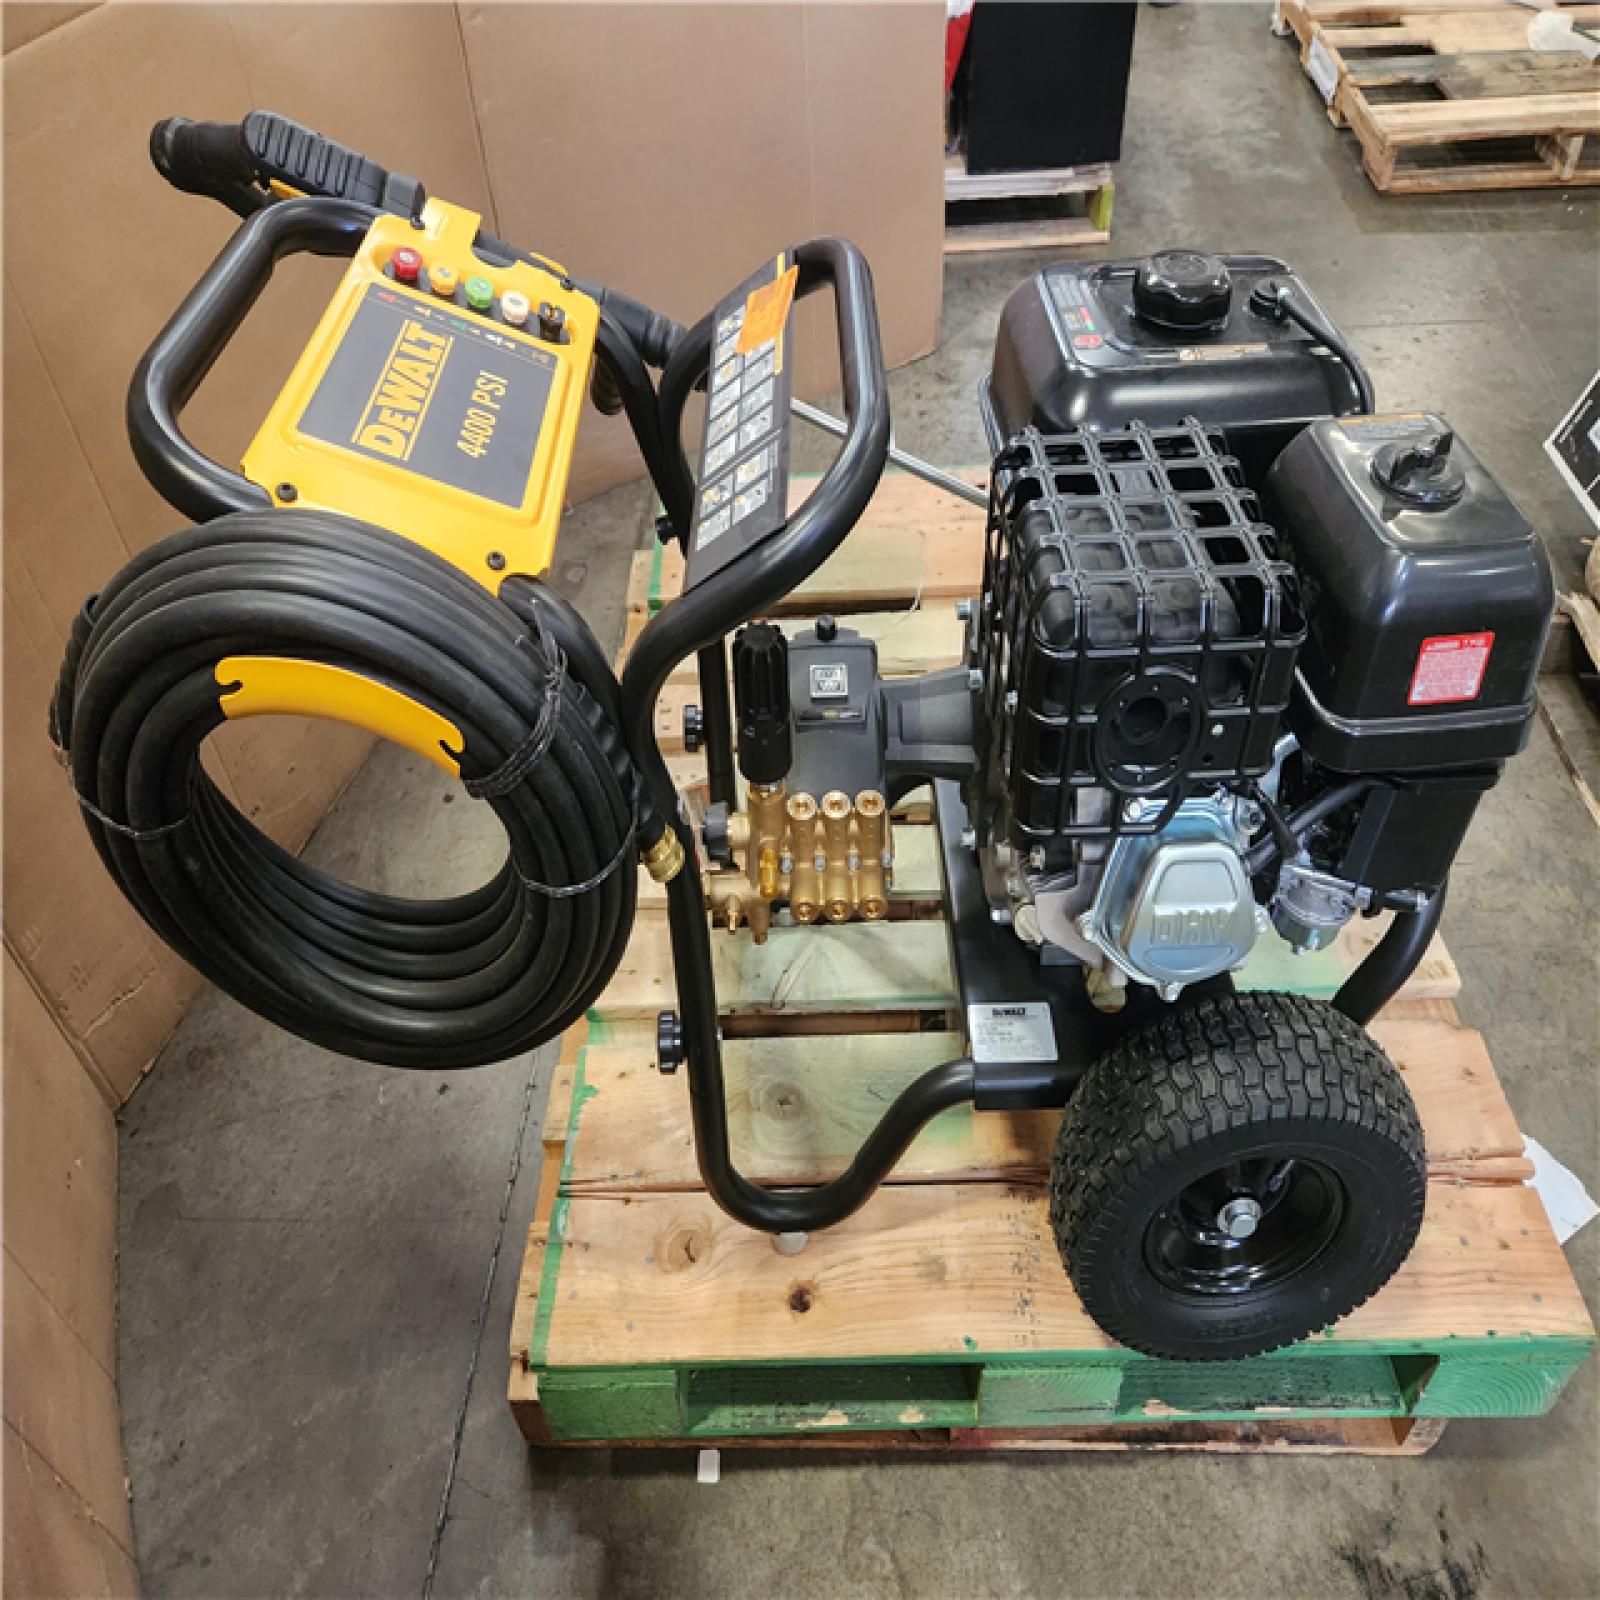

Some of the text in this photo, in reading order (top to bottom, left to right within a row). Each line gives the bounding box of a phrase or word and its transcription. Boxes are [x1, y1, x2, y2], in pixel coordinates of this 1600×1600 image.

[357, 323, 448, 459] DEWALT
[472, 369, 508, 408] PSI
[456, 408, 497, 458] 4400
